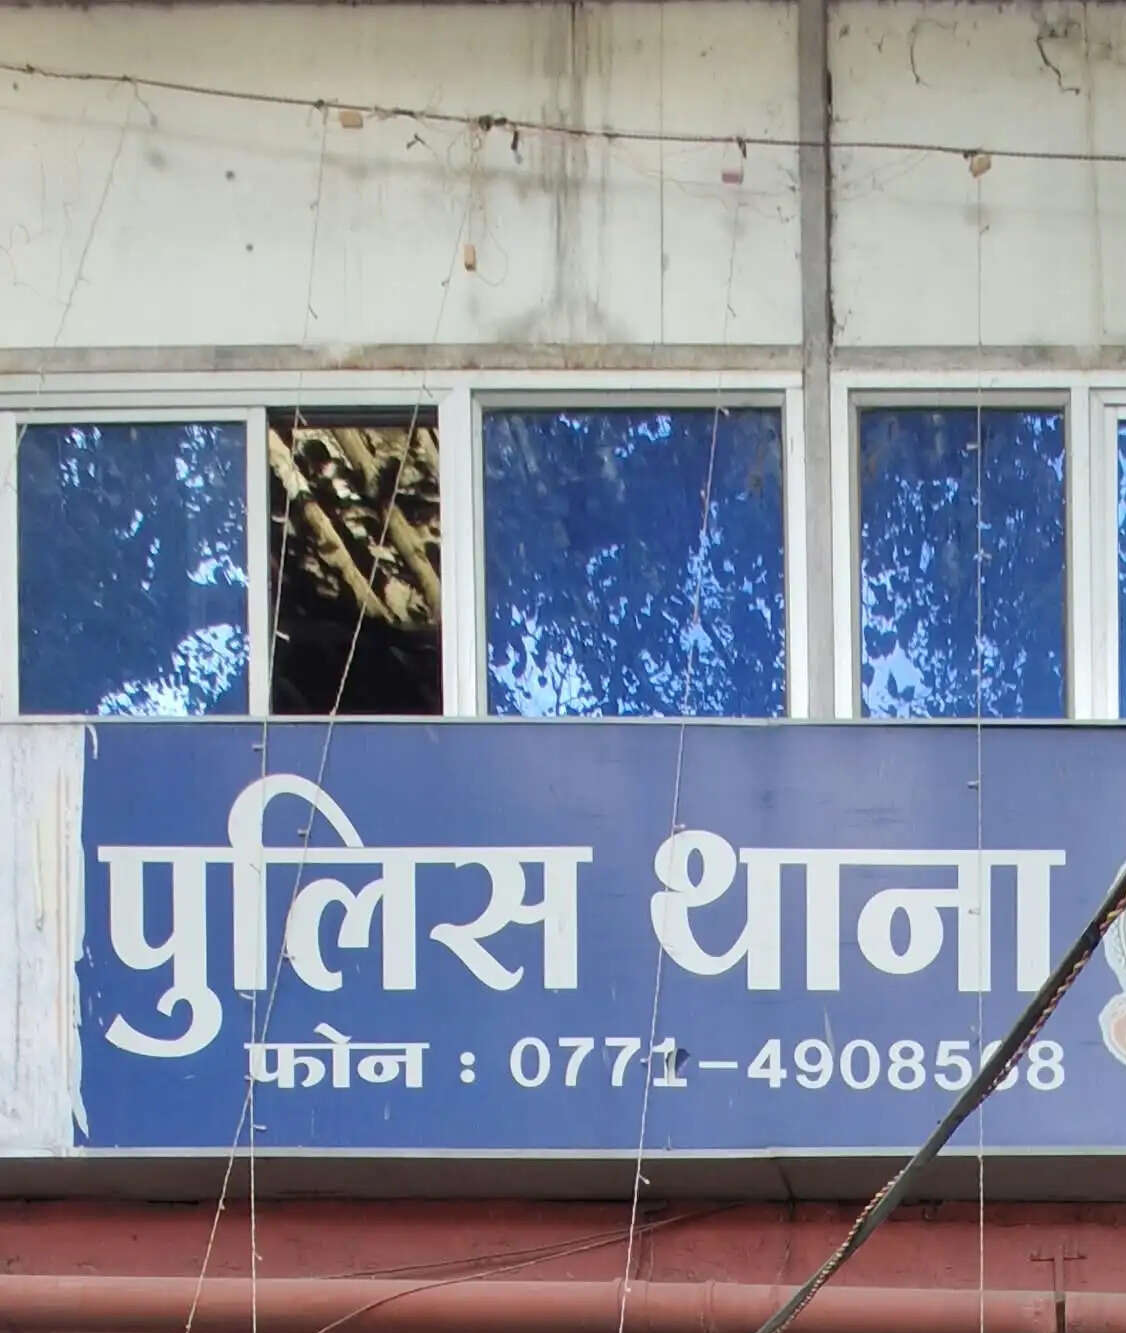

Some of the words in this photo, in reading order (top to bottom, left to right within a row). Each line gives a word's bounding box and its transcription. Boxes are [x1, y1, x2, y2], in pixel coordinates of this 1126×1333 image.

[98, 775, 593, 1057] पुलिस
[651, 831, 1065, 991] थाना
[245, 1023, 429, 1088] फोन
